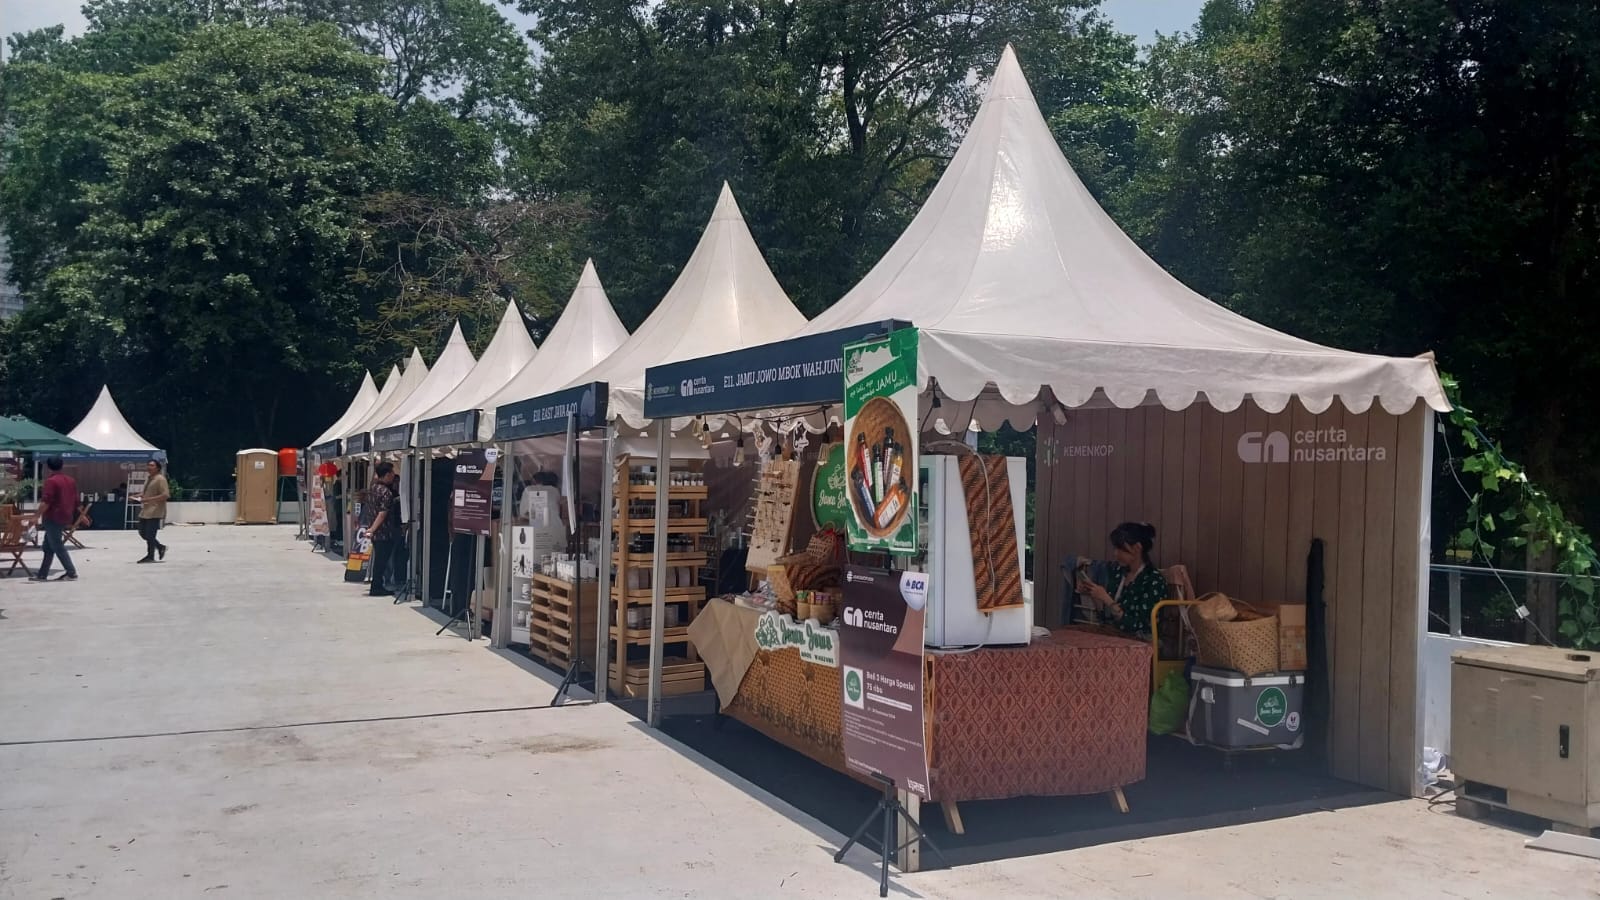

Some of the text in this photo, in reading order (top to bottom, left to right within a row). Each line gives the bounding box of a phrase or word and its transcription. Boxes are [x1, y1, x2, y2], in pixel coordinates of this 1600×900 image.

[736, 371, 755, 387] JAMU
[755, 367, 777, 384] JOWO
[778, 364, 801, 381] MBOK
[802, 357, 843, 377] WAHJUNI
[875, 370, 897, 391] JAMU
[541, 406, 554, 421] EAST
[1294, 426, 1347, 444] cerita
[1063, 444, 1114, 457] KEMENKOP
[1293, 444, 1386, 462] nusantara
[911, 581, 925, 590] BCA
[864, 609, 884, 621] cerita
[864, 620, 898, 634] nusantara
[880, 674, 896, 687] Harga
